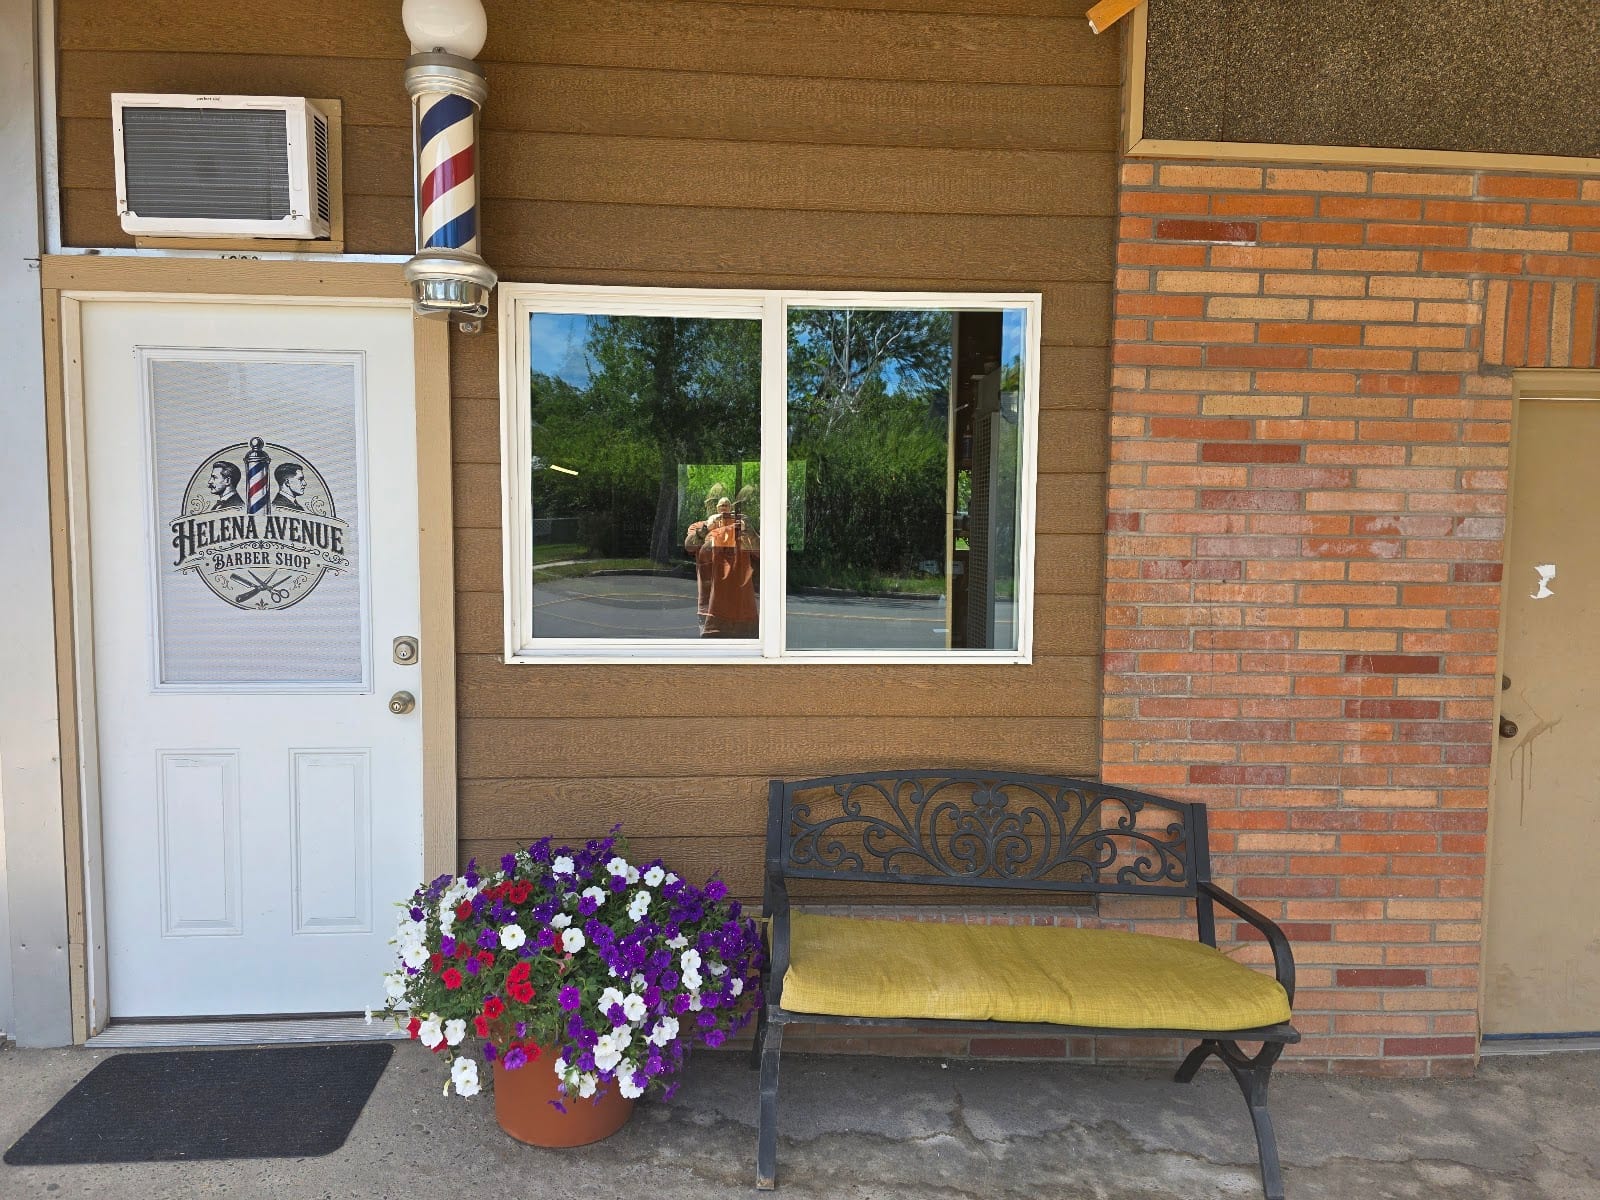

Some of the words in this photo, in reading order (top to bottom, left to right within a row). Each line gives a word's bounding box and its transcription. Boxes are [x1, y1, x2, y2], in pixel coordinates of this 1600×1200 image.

[171, 515, 258, 566] HELENA
[263, 515, 345, 554] AVENUE
[212, 551, 270, 571] BARBER
[275, 552, 311, 570] SHOP
